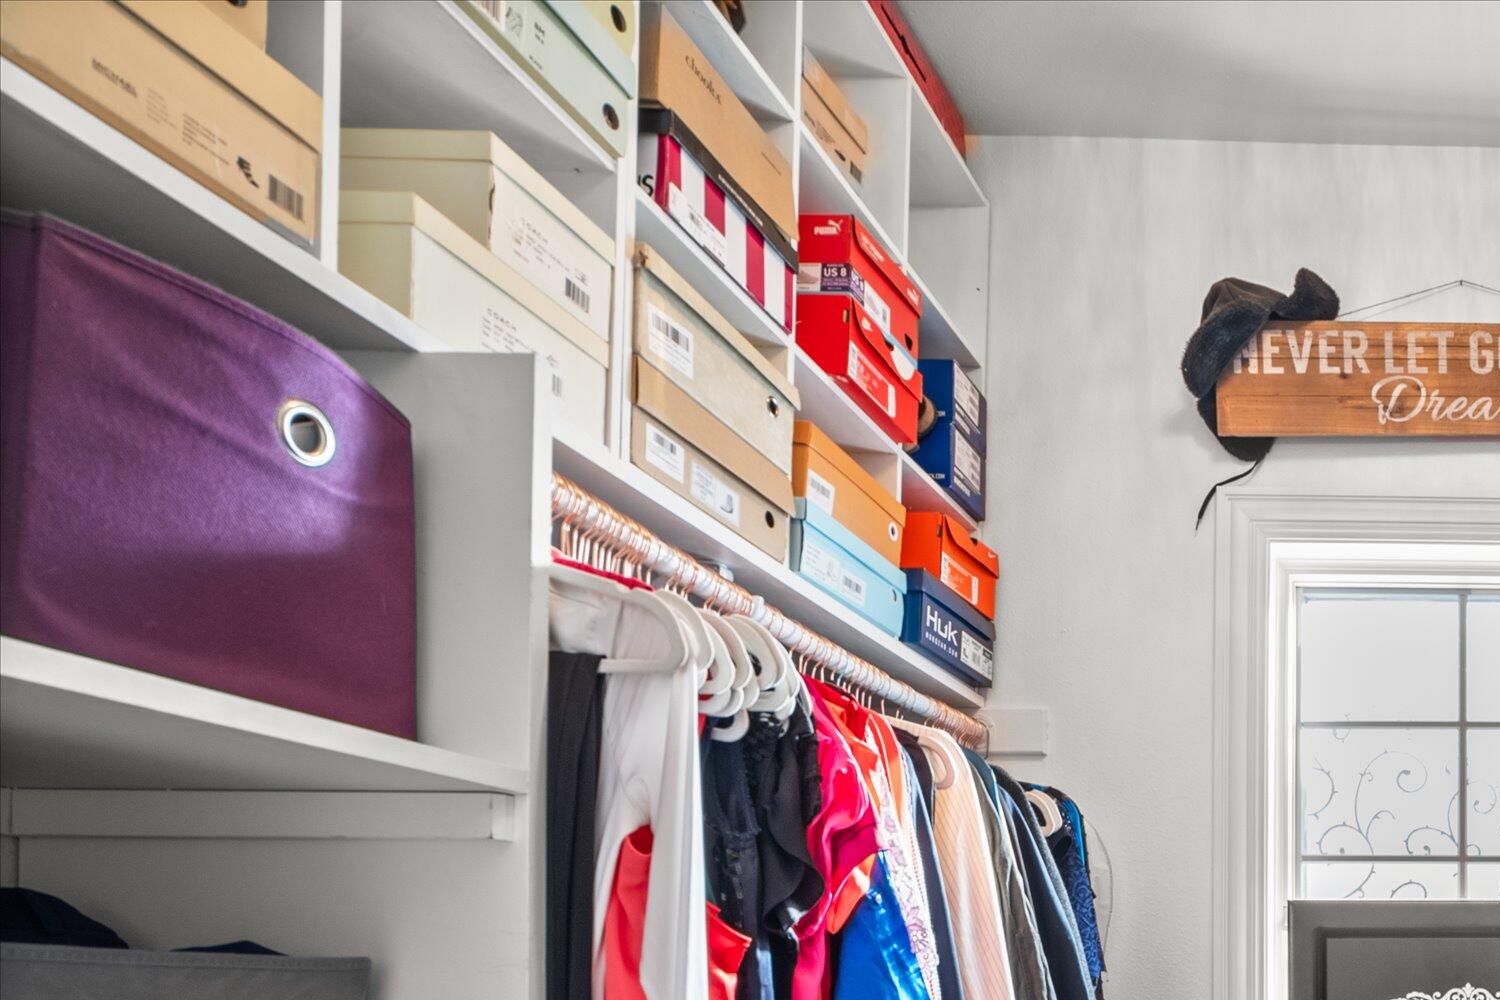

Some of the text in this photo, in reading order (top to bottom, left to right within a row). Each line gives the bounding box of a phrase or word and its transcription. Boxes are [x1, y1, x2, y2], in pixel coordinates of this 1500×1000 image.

[823, 267, 838, 278] US
[1233, 329, 1371, 375] NEVER
[1383, 330, 1455, 374] LET
